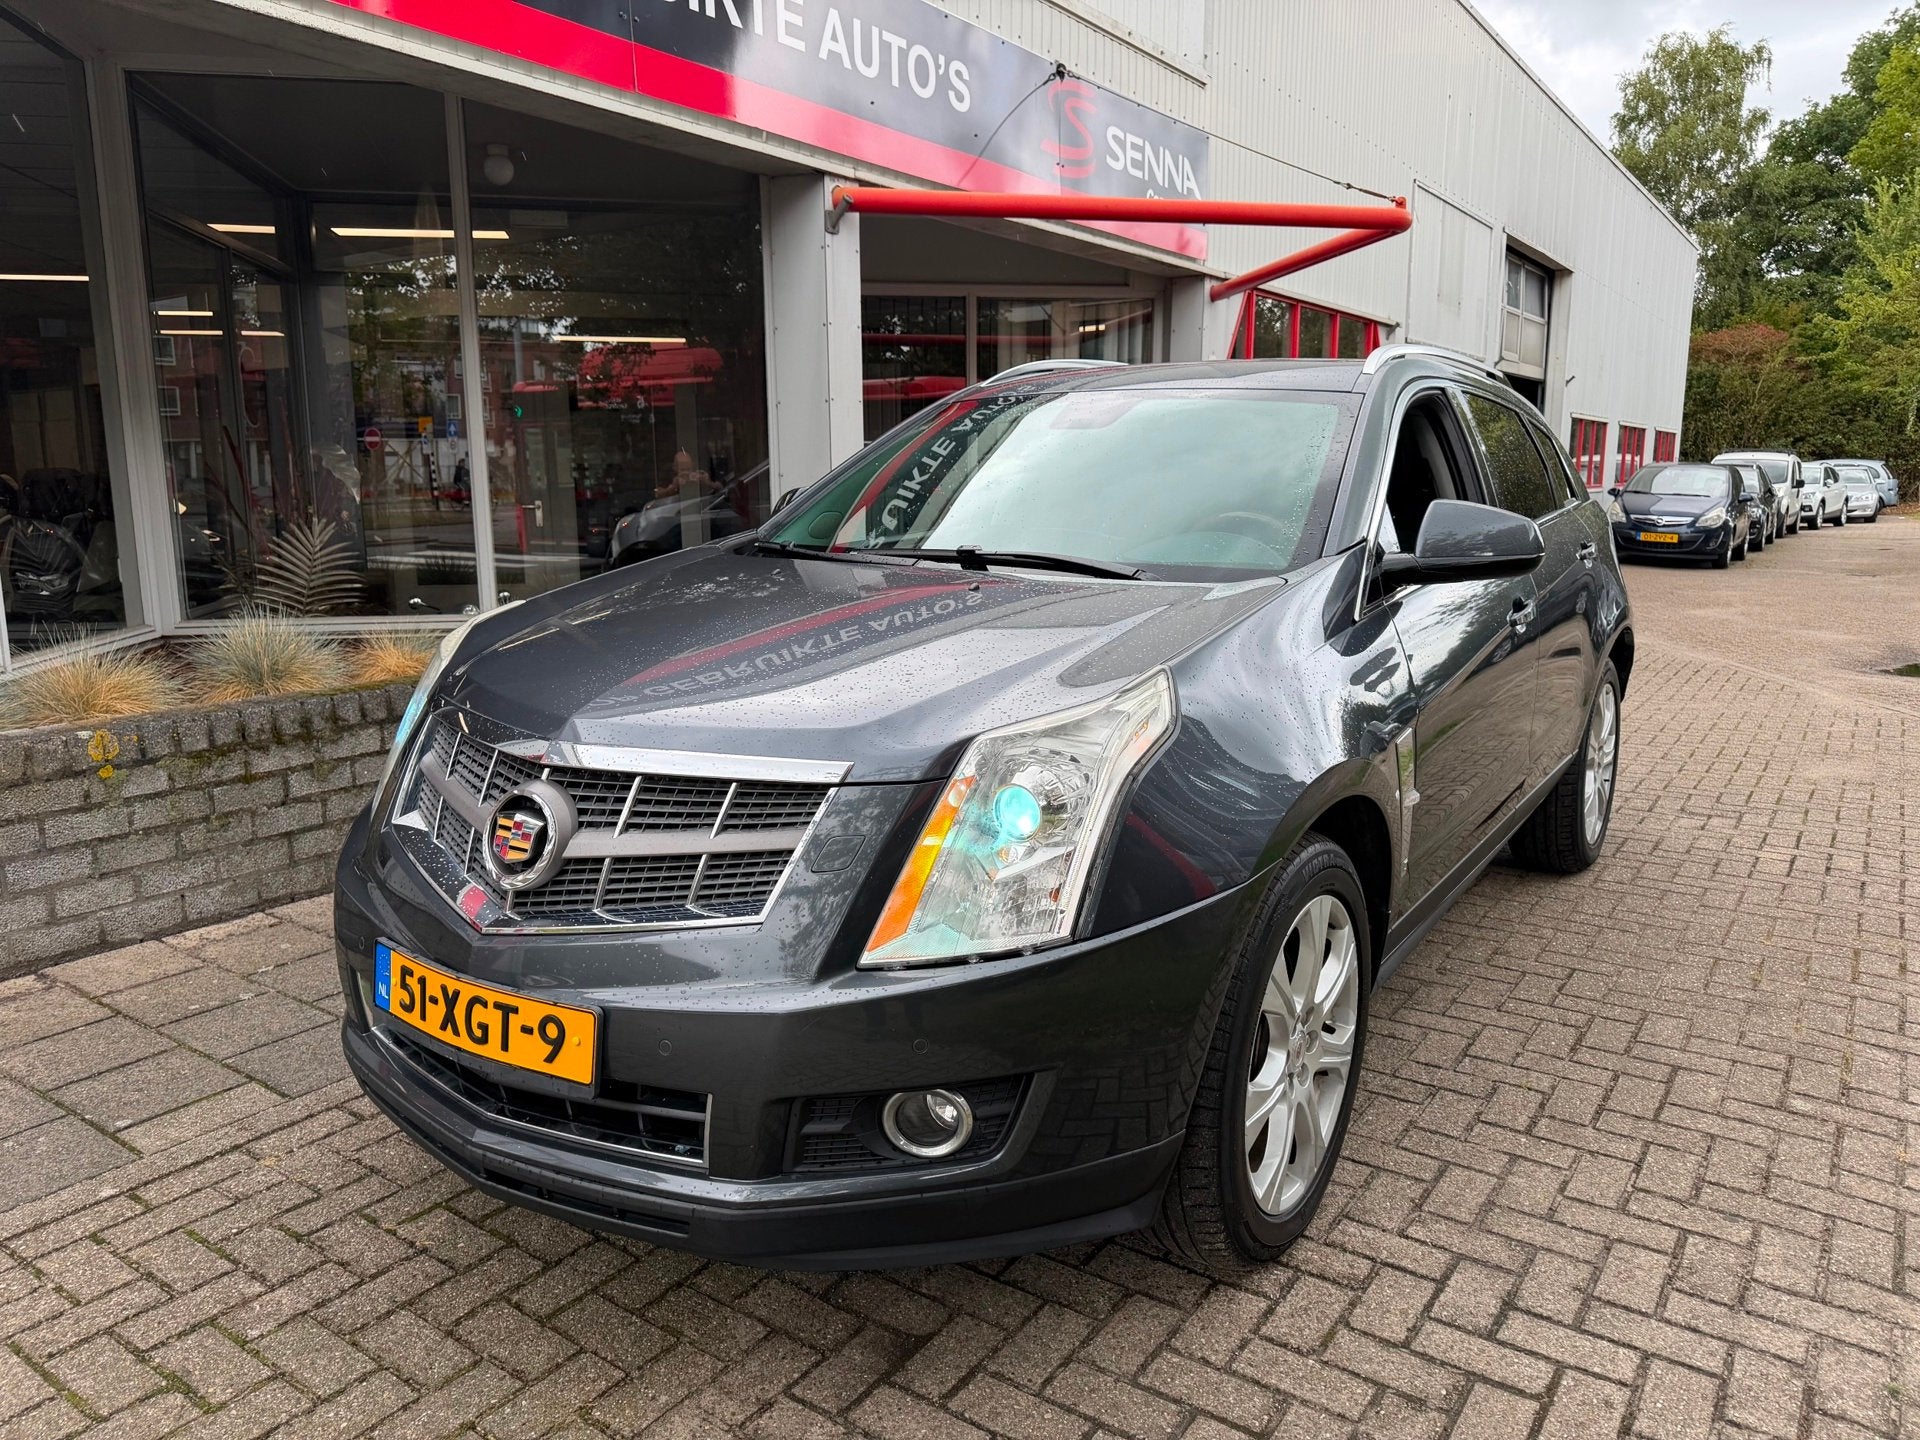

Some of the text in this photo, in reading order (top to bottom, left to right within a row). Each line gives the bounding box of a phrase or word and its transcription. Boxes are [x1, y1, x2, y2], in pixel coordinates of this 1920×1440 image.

[818, 7, 971, 113] AUTO'S
[1105, 125, 1201, 201] SENNA
[378, 981, 390, 1000] NL
[398, 964, 567, 1064] 51-XGT-9
